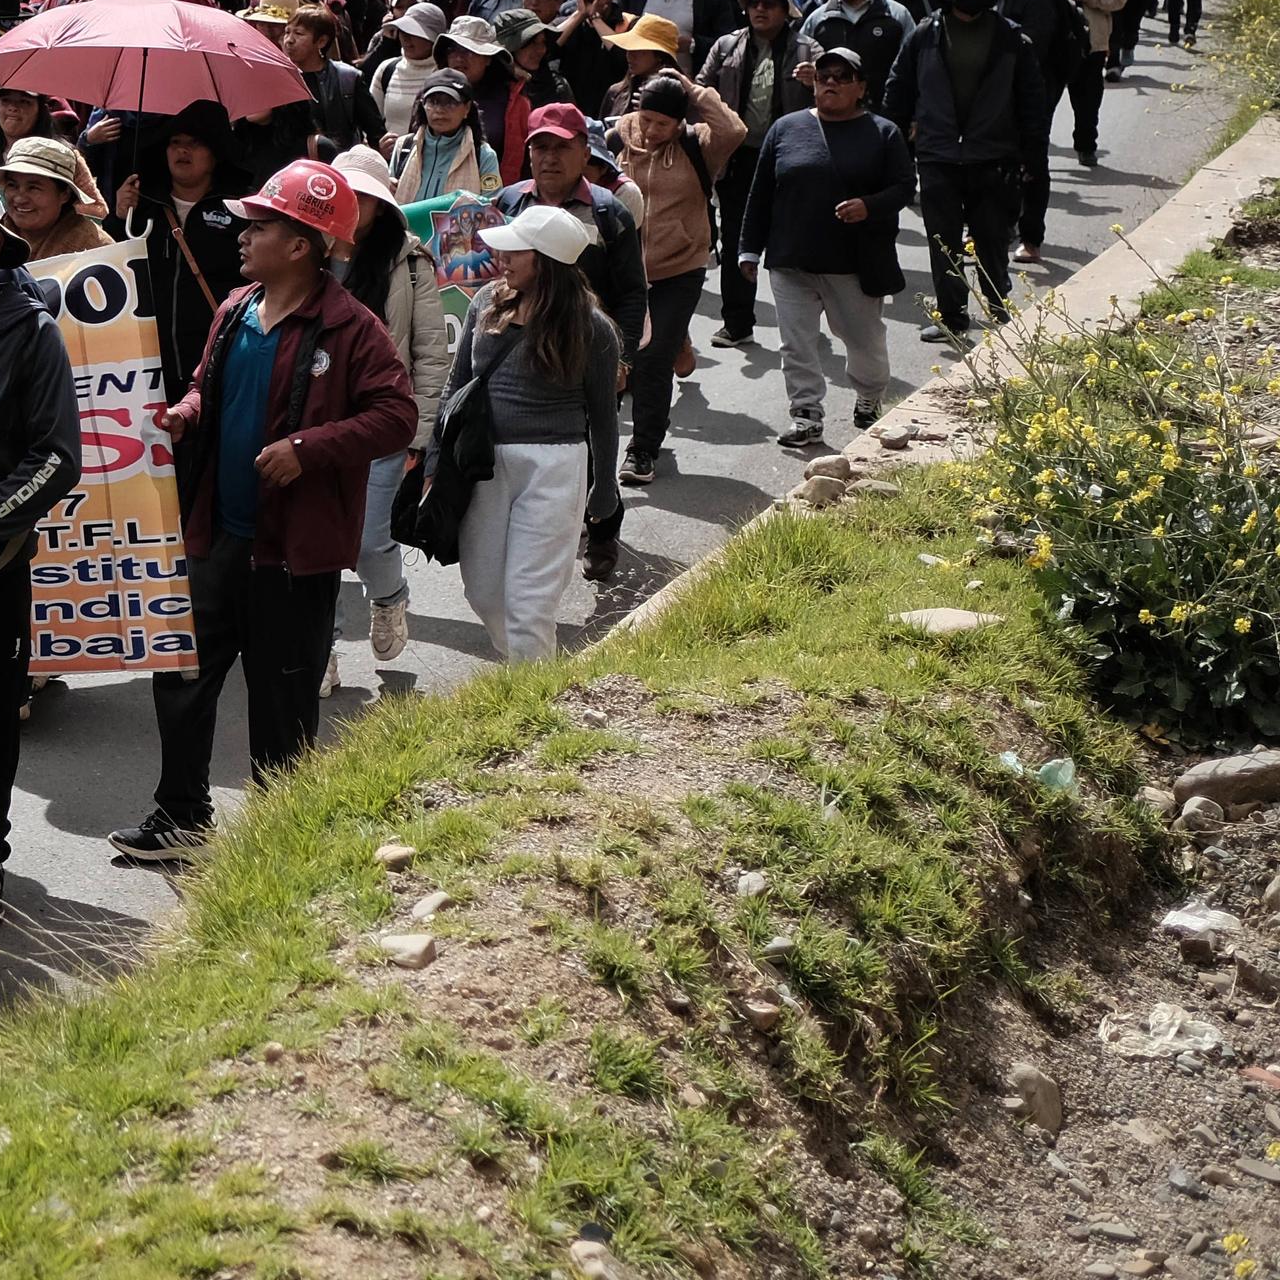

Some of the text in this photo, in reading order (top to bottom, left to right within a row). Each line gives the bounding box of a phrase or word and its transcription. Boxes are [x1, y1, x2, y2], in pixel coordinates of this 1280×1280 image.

[295, 191, 336, 216] FABRILES
[77, 368, 163, 397] ENT
[40, 521, 178, 549] T.F.L.
[31, 556, 188, 583] stitu
[35, 592, 192, 621] ndic
[38, 630, 195, 662] baja
